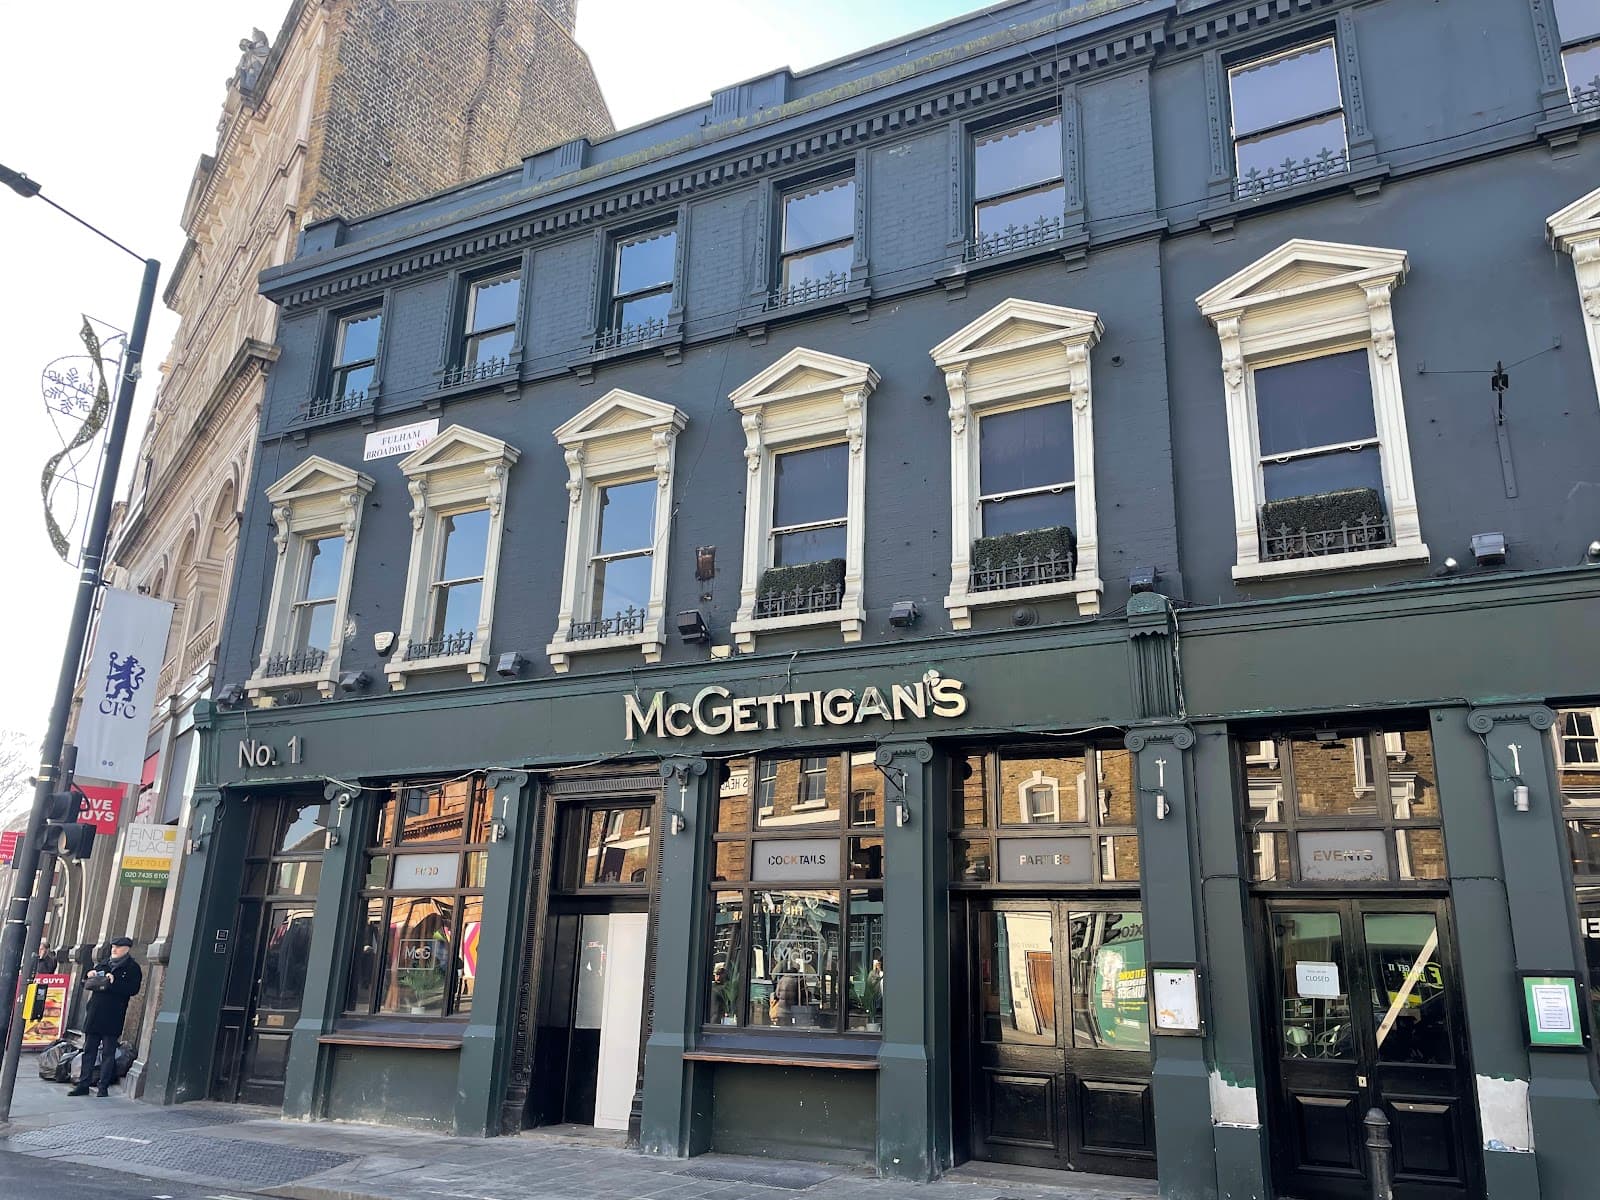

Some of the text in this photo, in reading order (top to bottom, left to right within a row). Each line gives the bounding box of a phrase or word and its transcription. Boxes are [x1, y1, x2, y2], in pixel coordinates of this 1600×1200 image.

[382, 429, 420, 446] FULHAM
[366, 438, 428, 459] BROADWAY SW
[99, 700, 137, 719] CFC
[238, 735, 299, 769] No. 1
[130, 827, 164, 841] FIND
[128, 840, 176, 855] PLACE
[1313, 848, 1374, 862] EVENTS
[768, 854, 826, 866] COCKTAILS
[1018, 854, 1071, 866] PARTIES
[404, 945, 431, 960] McG
[1305, 975, 1330, 983] CLOSED
